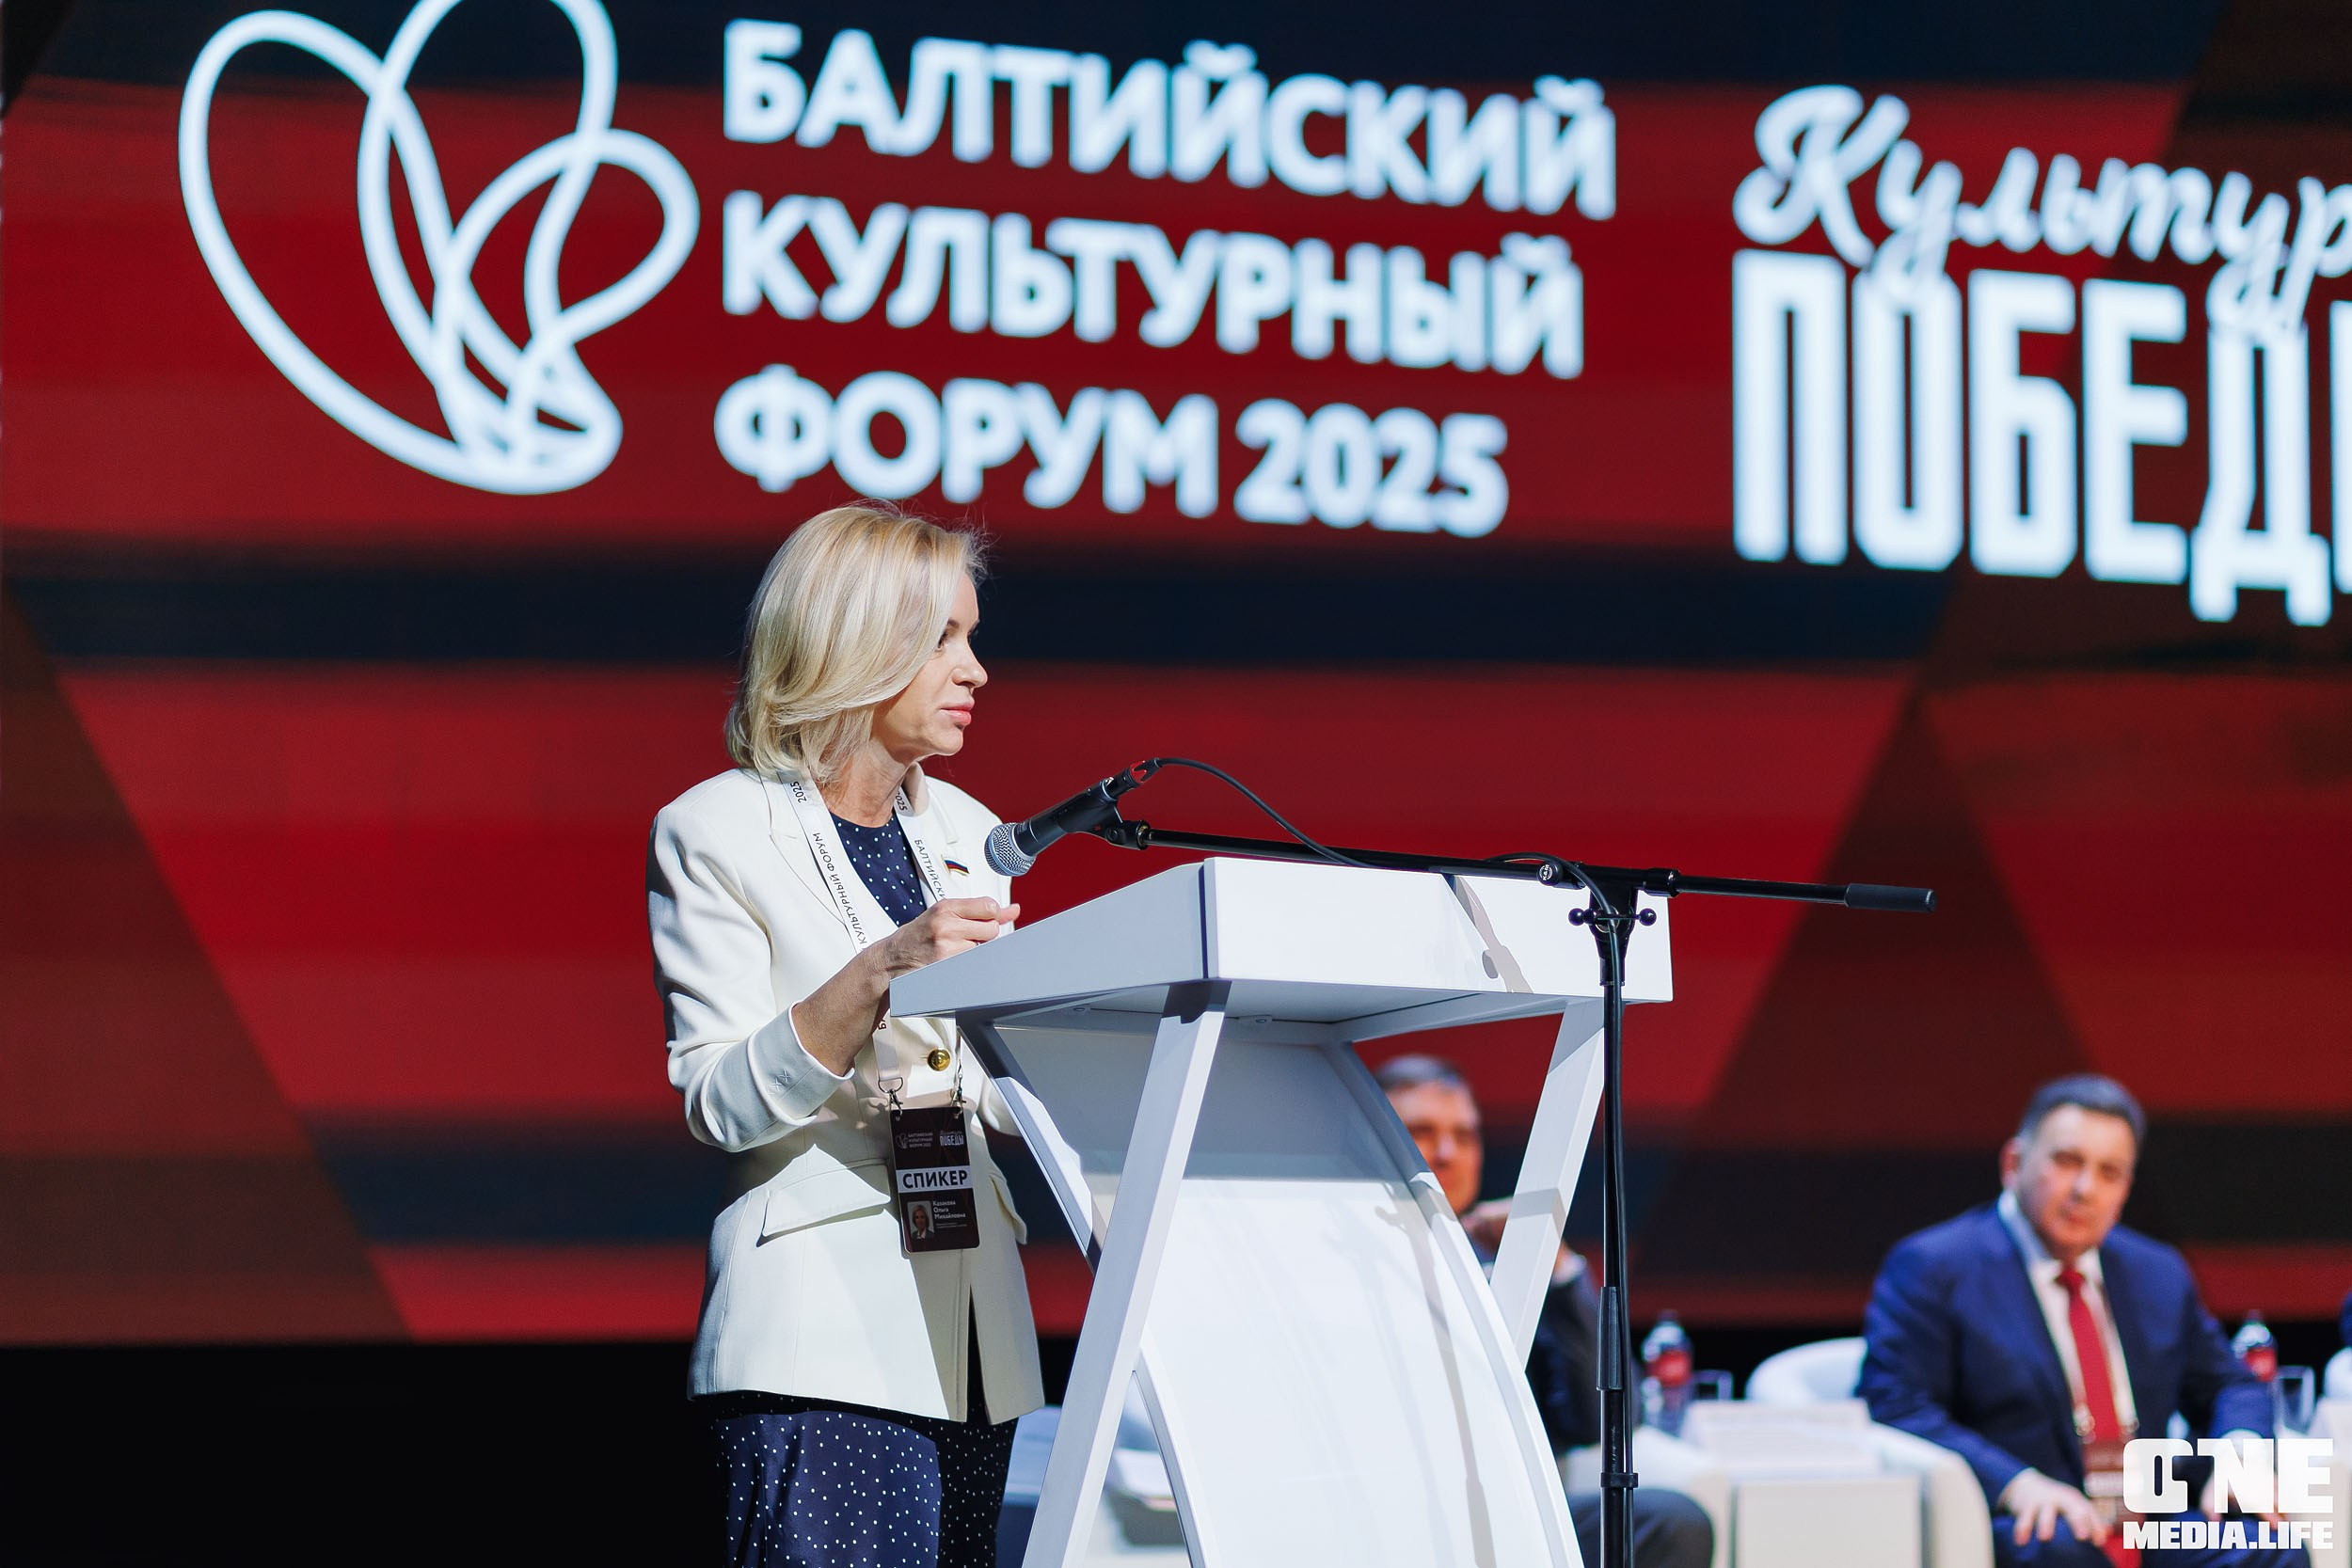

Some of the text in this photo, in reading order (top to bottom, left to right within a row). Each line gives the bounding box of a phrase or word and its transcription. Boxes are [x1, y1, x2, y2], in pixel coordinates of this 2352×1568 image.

[723, 19, 1616, 220] БАЛТИЙСКИЙ
[723, 190, 1583, 379] КУЛЬТУРНЫЙ
[714, 364, 1508, 537] ФОРУМ 2025
[790, 781, 867, 944] КУЛЬТУРНЫЙ ФОРУМ 2025
[902, 1169, 968, 1189] СПИКЕР
